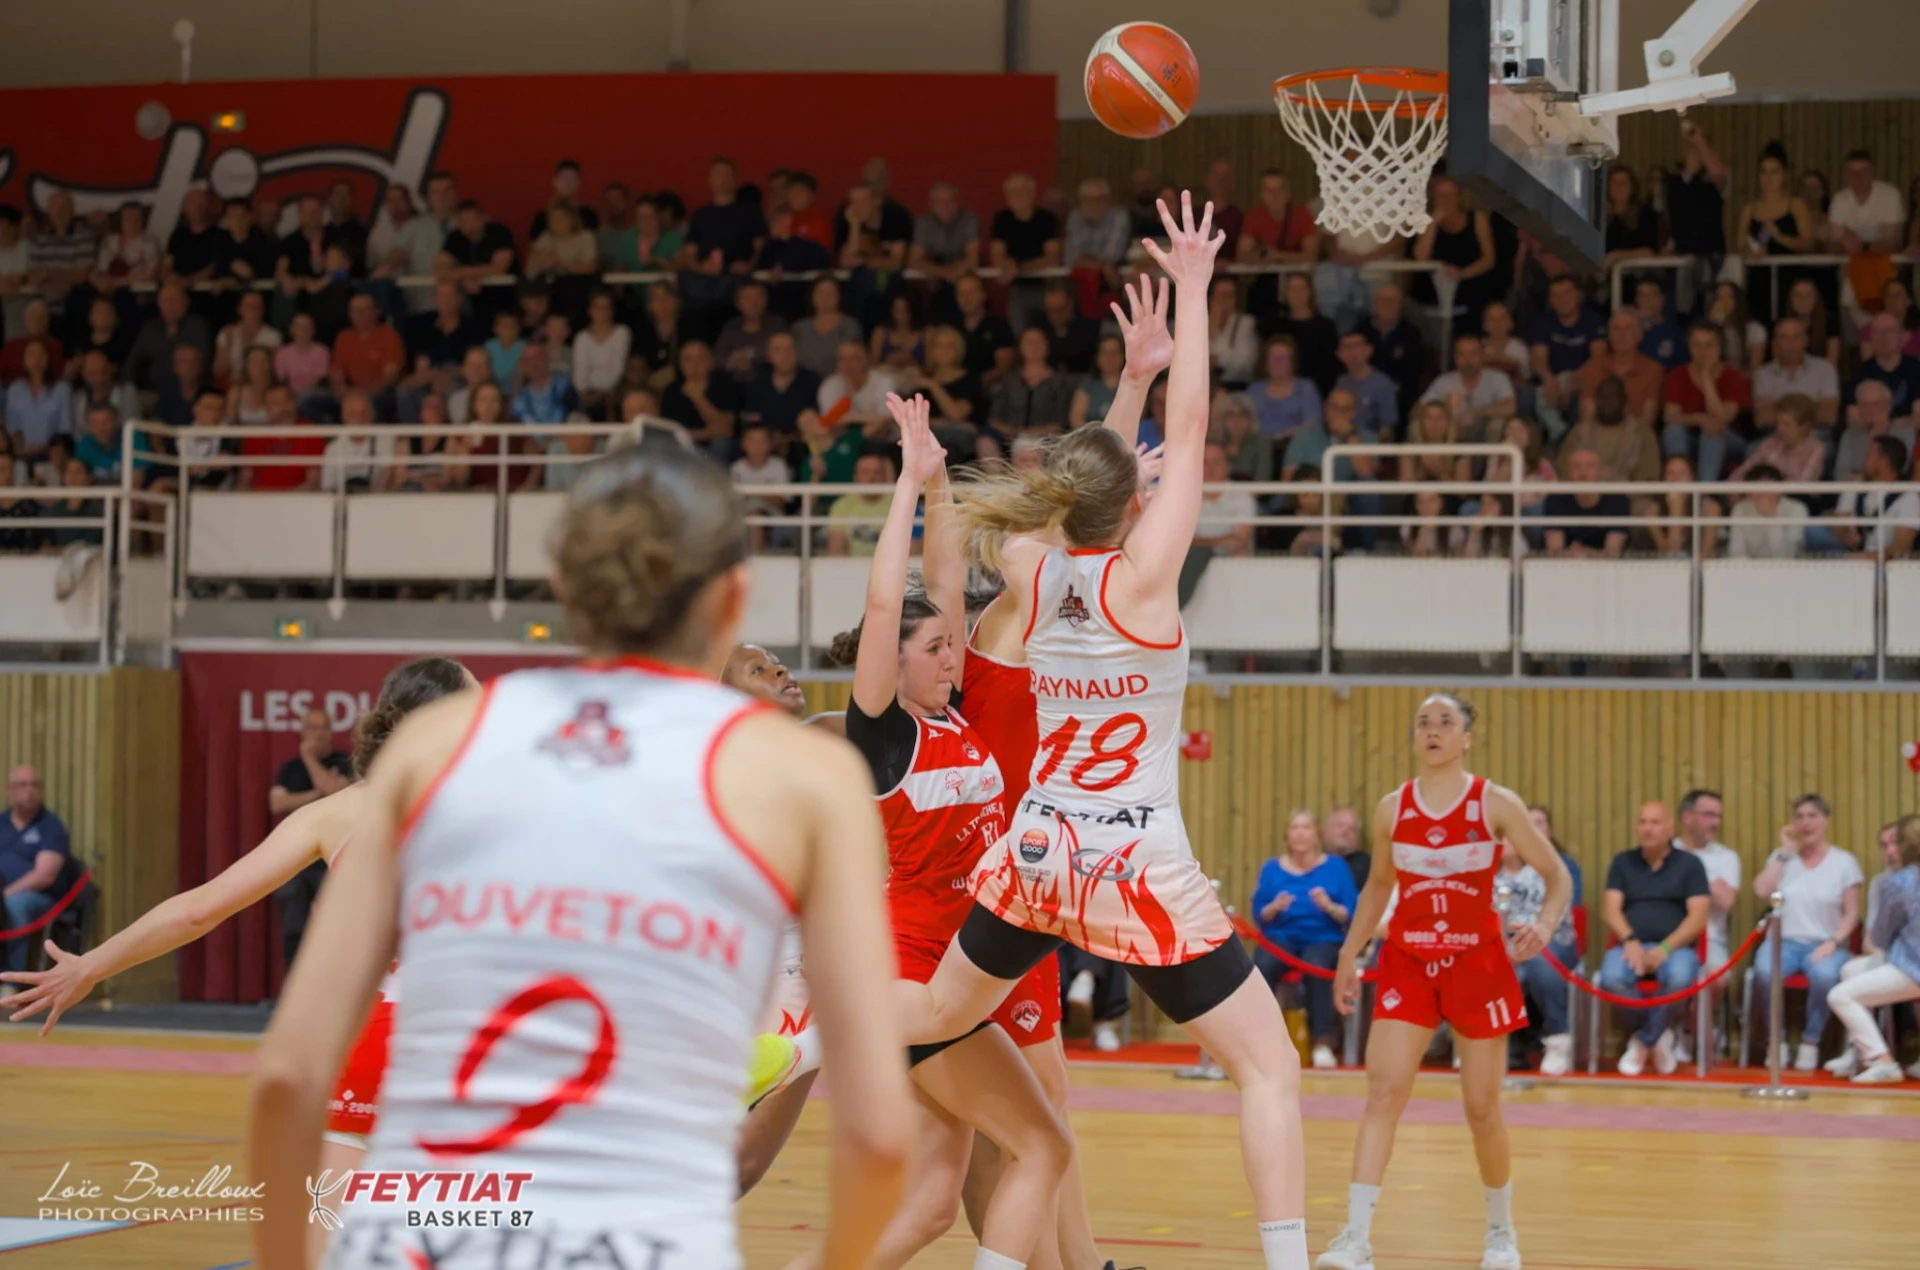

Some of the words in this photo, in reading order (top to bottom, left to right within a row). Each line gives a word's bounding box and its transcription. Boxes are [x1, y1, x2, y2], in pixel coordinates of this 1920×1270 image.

[240, 690, 313, 731] LES
[1036, 712, 1147, 792] 18
[1022, 837, 1048, 847] SPORT
[1022, 845, 1044, 854] 2000
[1430, 893, 1448, 914] 11
[1485, 997, 1511, 1029] 11
[413, 971, 616, 1160] 9
